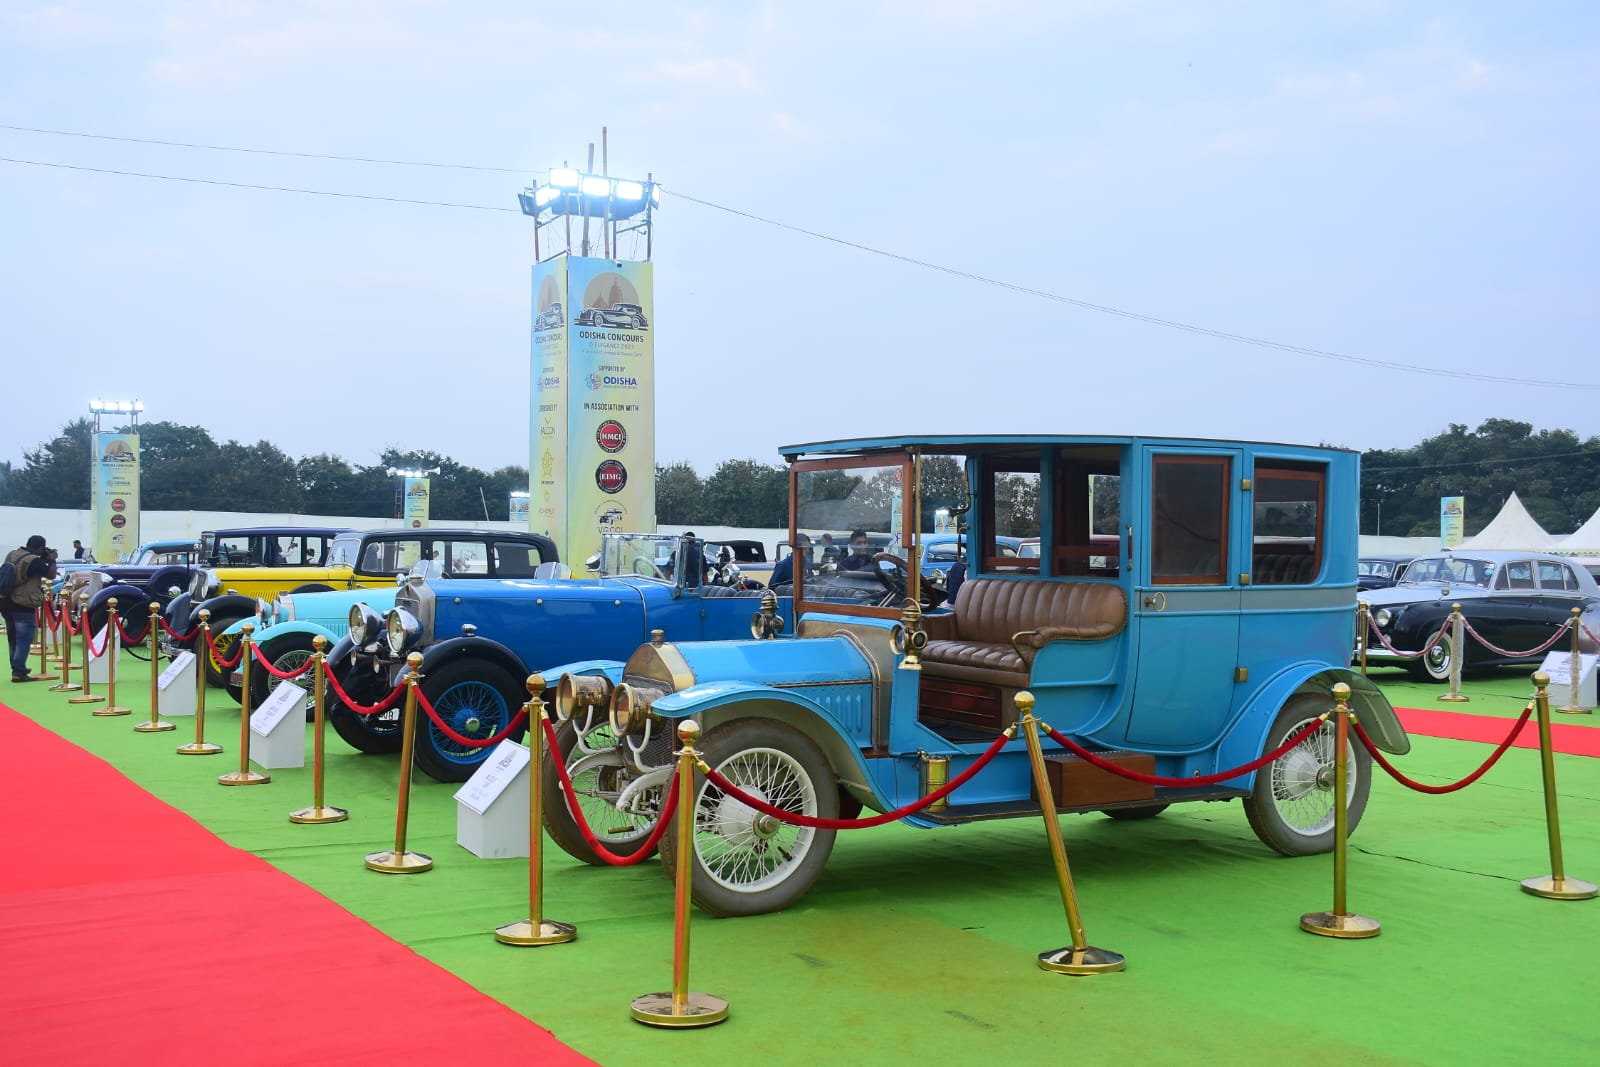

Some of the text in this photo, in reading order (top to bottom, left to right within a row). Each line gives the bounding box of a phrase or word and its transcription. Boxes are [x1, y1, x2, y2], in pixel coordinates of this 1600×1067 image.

[580, 331, 644, 342] ODISHA CONCOURS
[603, 376, 637, 386] ODISHA
[590, 403, 625, 411] ASSOCIATION
